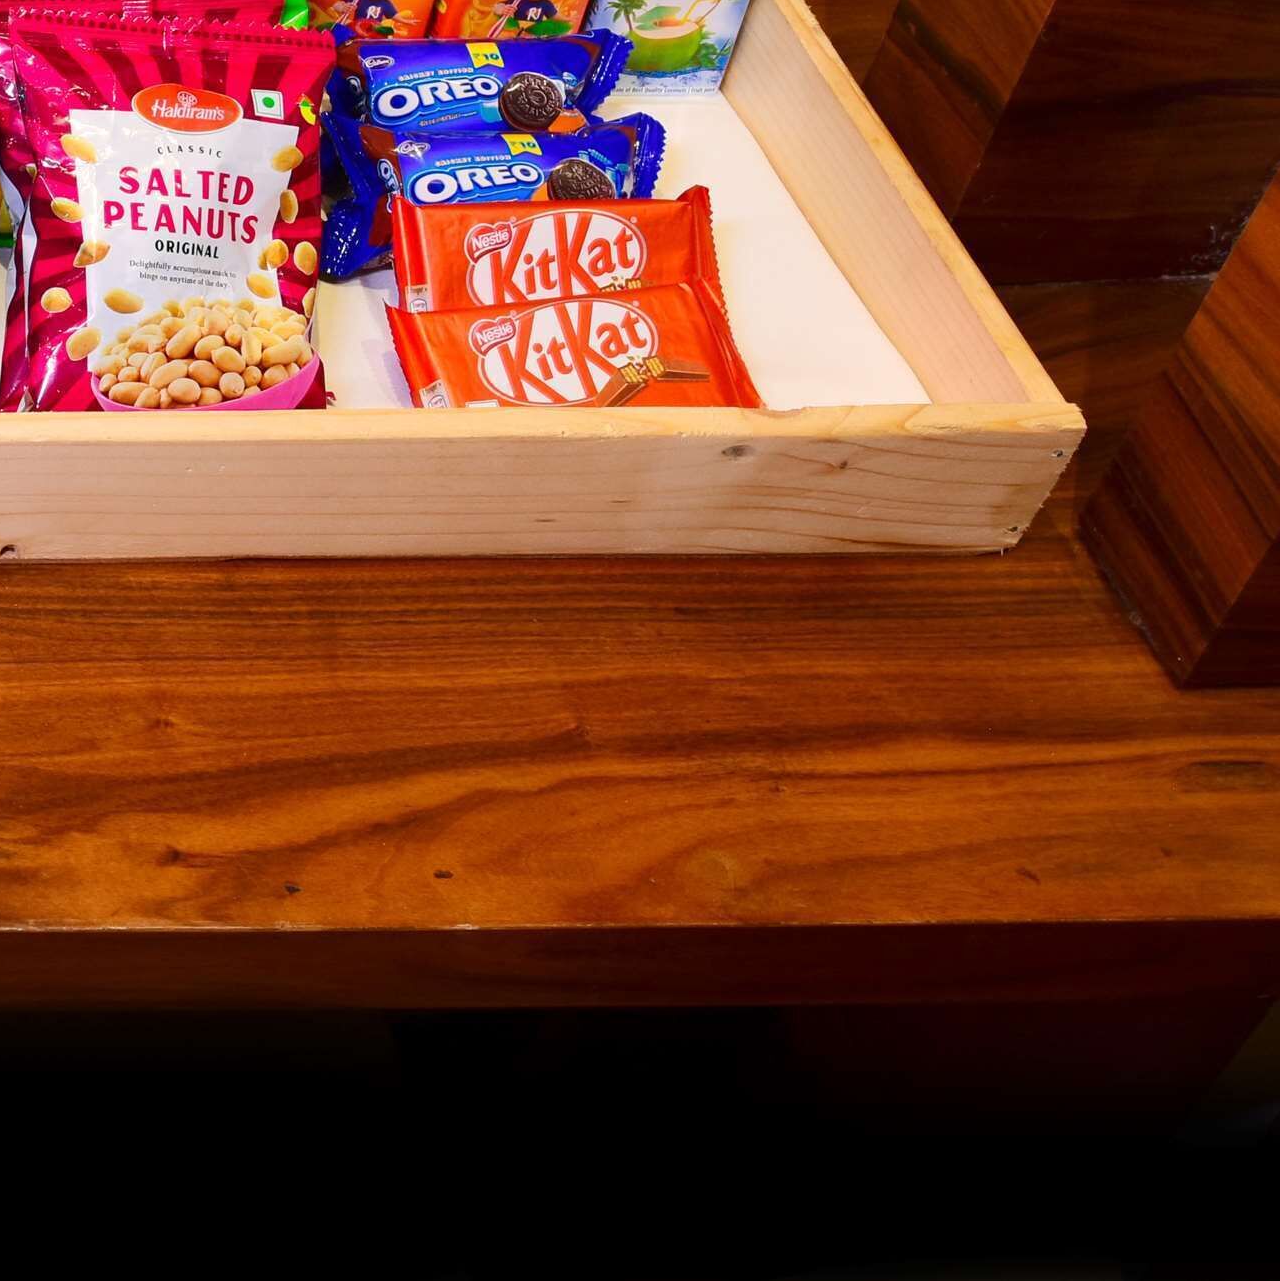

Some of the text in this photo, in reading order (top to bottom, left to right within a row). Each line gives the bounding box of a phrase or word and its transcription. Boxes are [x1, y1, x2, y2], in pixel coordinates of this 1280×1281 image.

[151, 99, 224, 120] Haldiram's
[378, 76, 499, 118] OREO
[157, 145, 222, 158] CLASSIC
[119, 166, 254, 206] SALTED
[414, 164, 538, 203] OREO
[103, 200, 258, 244] PEANUTS
[129, 259, 172, 271] Delightfully
[155, 239, 219, 259] ORIGINAL
[491, 212, 636, 305] KitKat
[502, 301, 648, 403] KitKat
